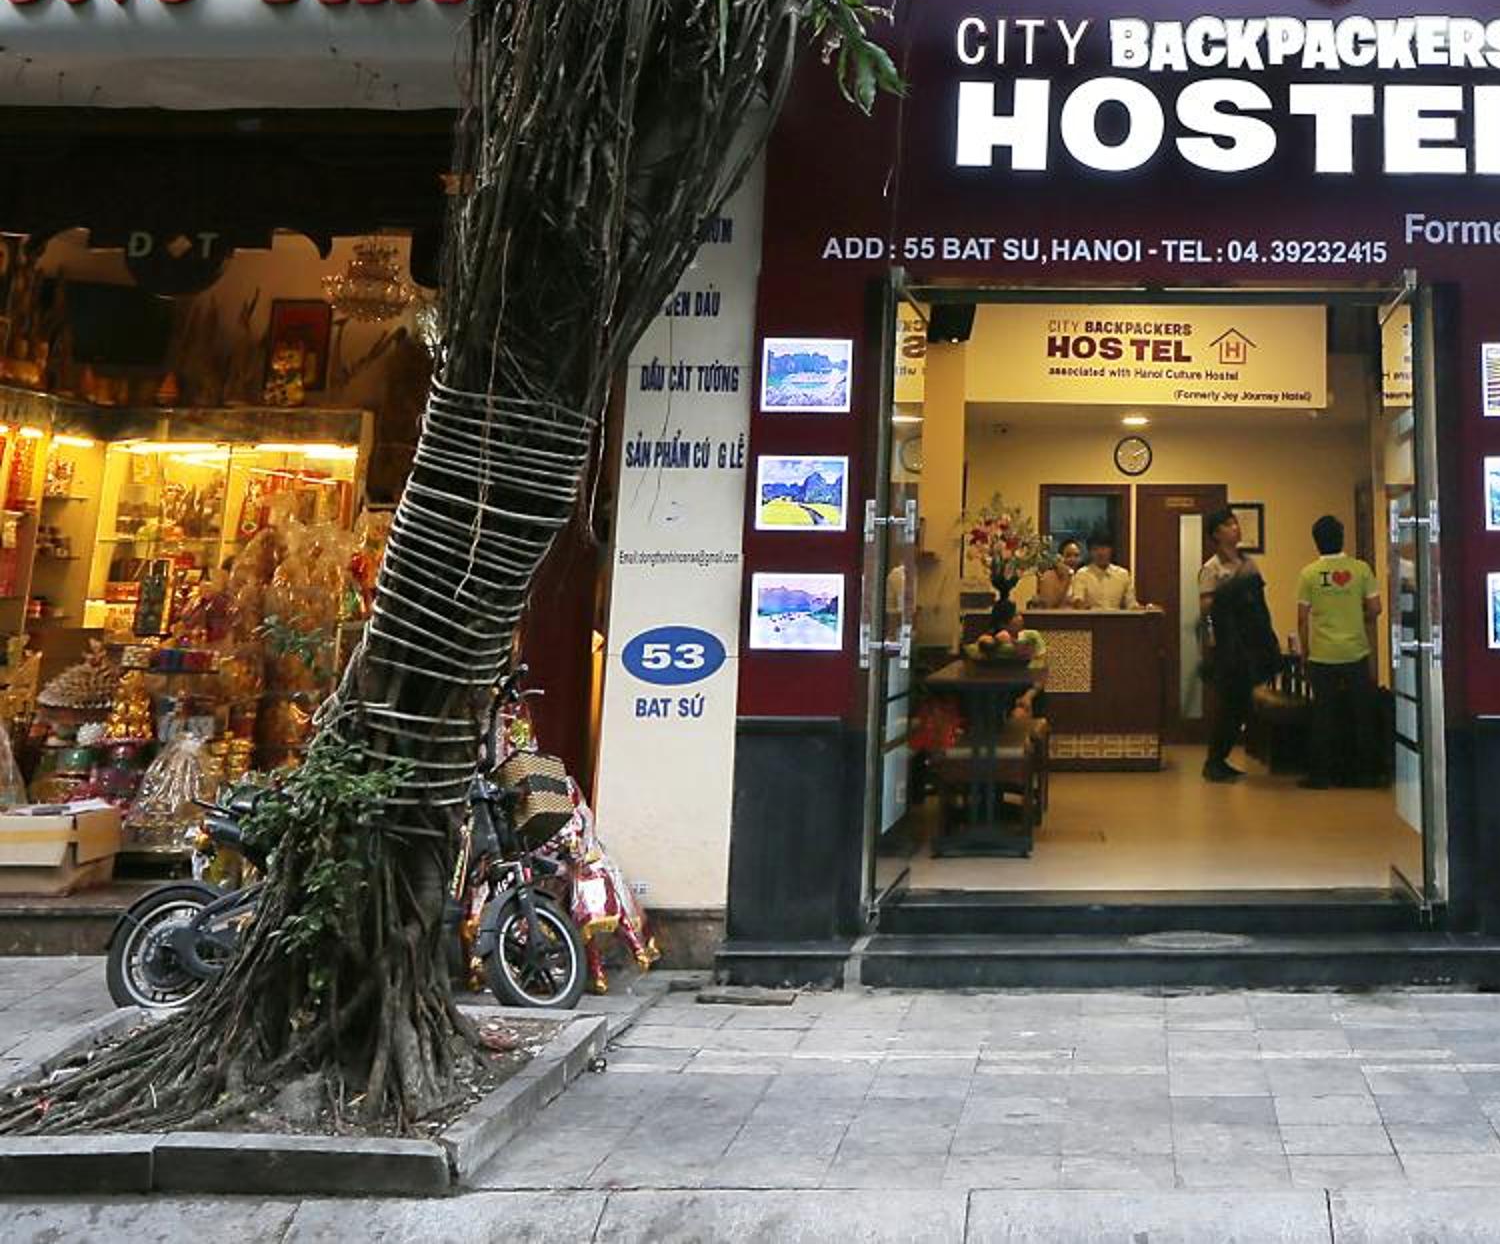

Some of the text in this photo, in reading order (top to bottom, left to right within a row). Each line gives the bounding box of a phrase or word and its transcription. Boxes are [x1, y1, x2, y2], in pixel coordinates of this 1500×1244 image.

[956, 17, 1089, 65] CITY
[903, 237, 935, 259] 55
[942, 237, 996, 260] BAT
[1047, 320, 1192, 336] CITY BACKPACKERS
[1048, 367, 1239, 381] associated with Hanoi Culture Hostel
[1221, 391, 1239, 403] Joy
[1241, 391, 1280, 404] Journey
[641, 643, 705, 669] 53
[635, 698, 672, 717] BAT
